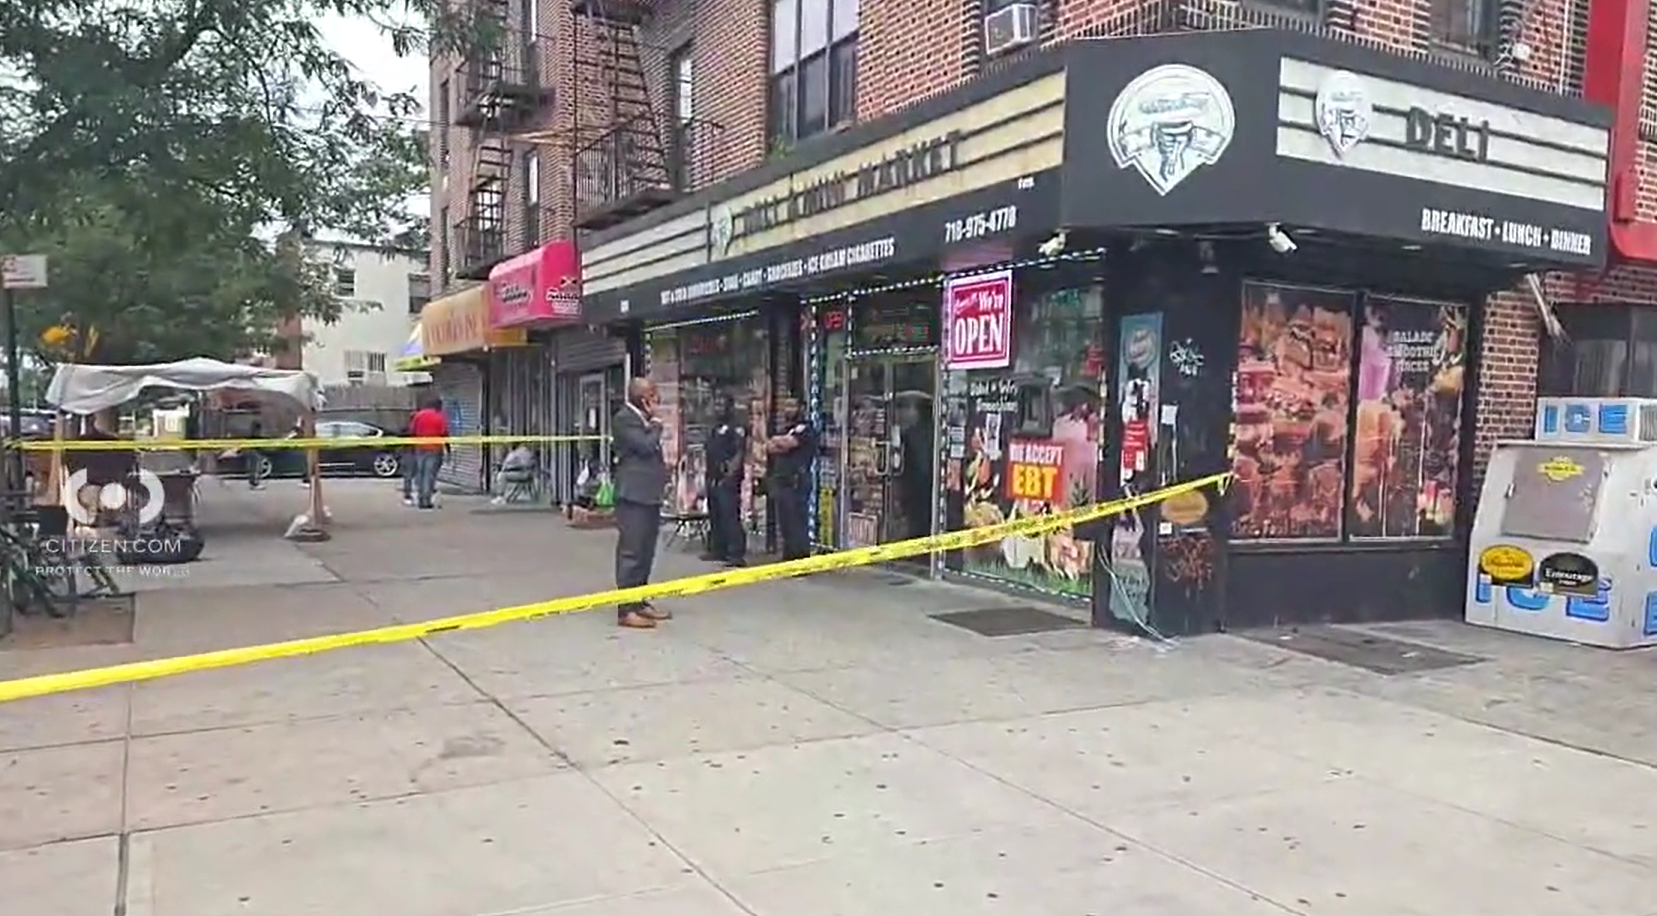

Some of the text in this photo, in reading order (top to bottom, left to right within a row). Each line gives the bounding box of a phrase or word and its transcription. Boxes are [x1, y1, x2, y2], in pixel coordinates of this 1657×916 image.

[1406, 107, 1488, 164] DELI
[857, 129, 961, 199] MARKET
[1421, 207, 1591, 256] BREAKFAST LUNCH DINNER
[847, 237, 896, 267] CIGARETTES
[955, 312, 1003, 355] OPEN
[1544, 404, 1628, 434] ICE
[1025, 445, 1063, 466] ACCEPT
[1012, 463, 1058, 499] EBT
